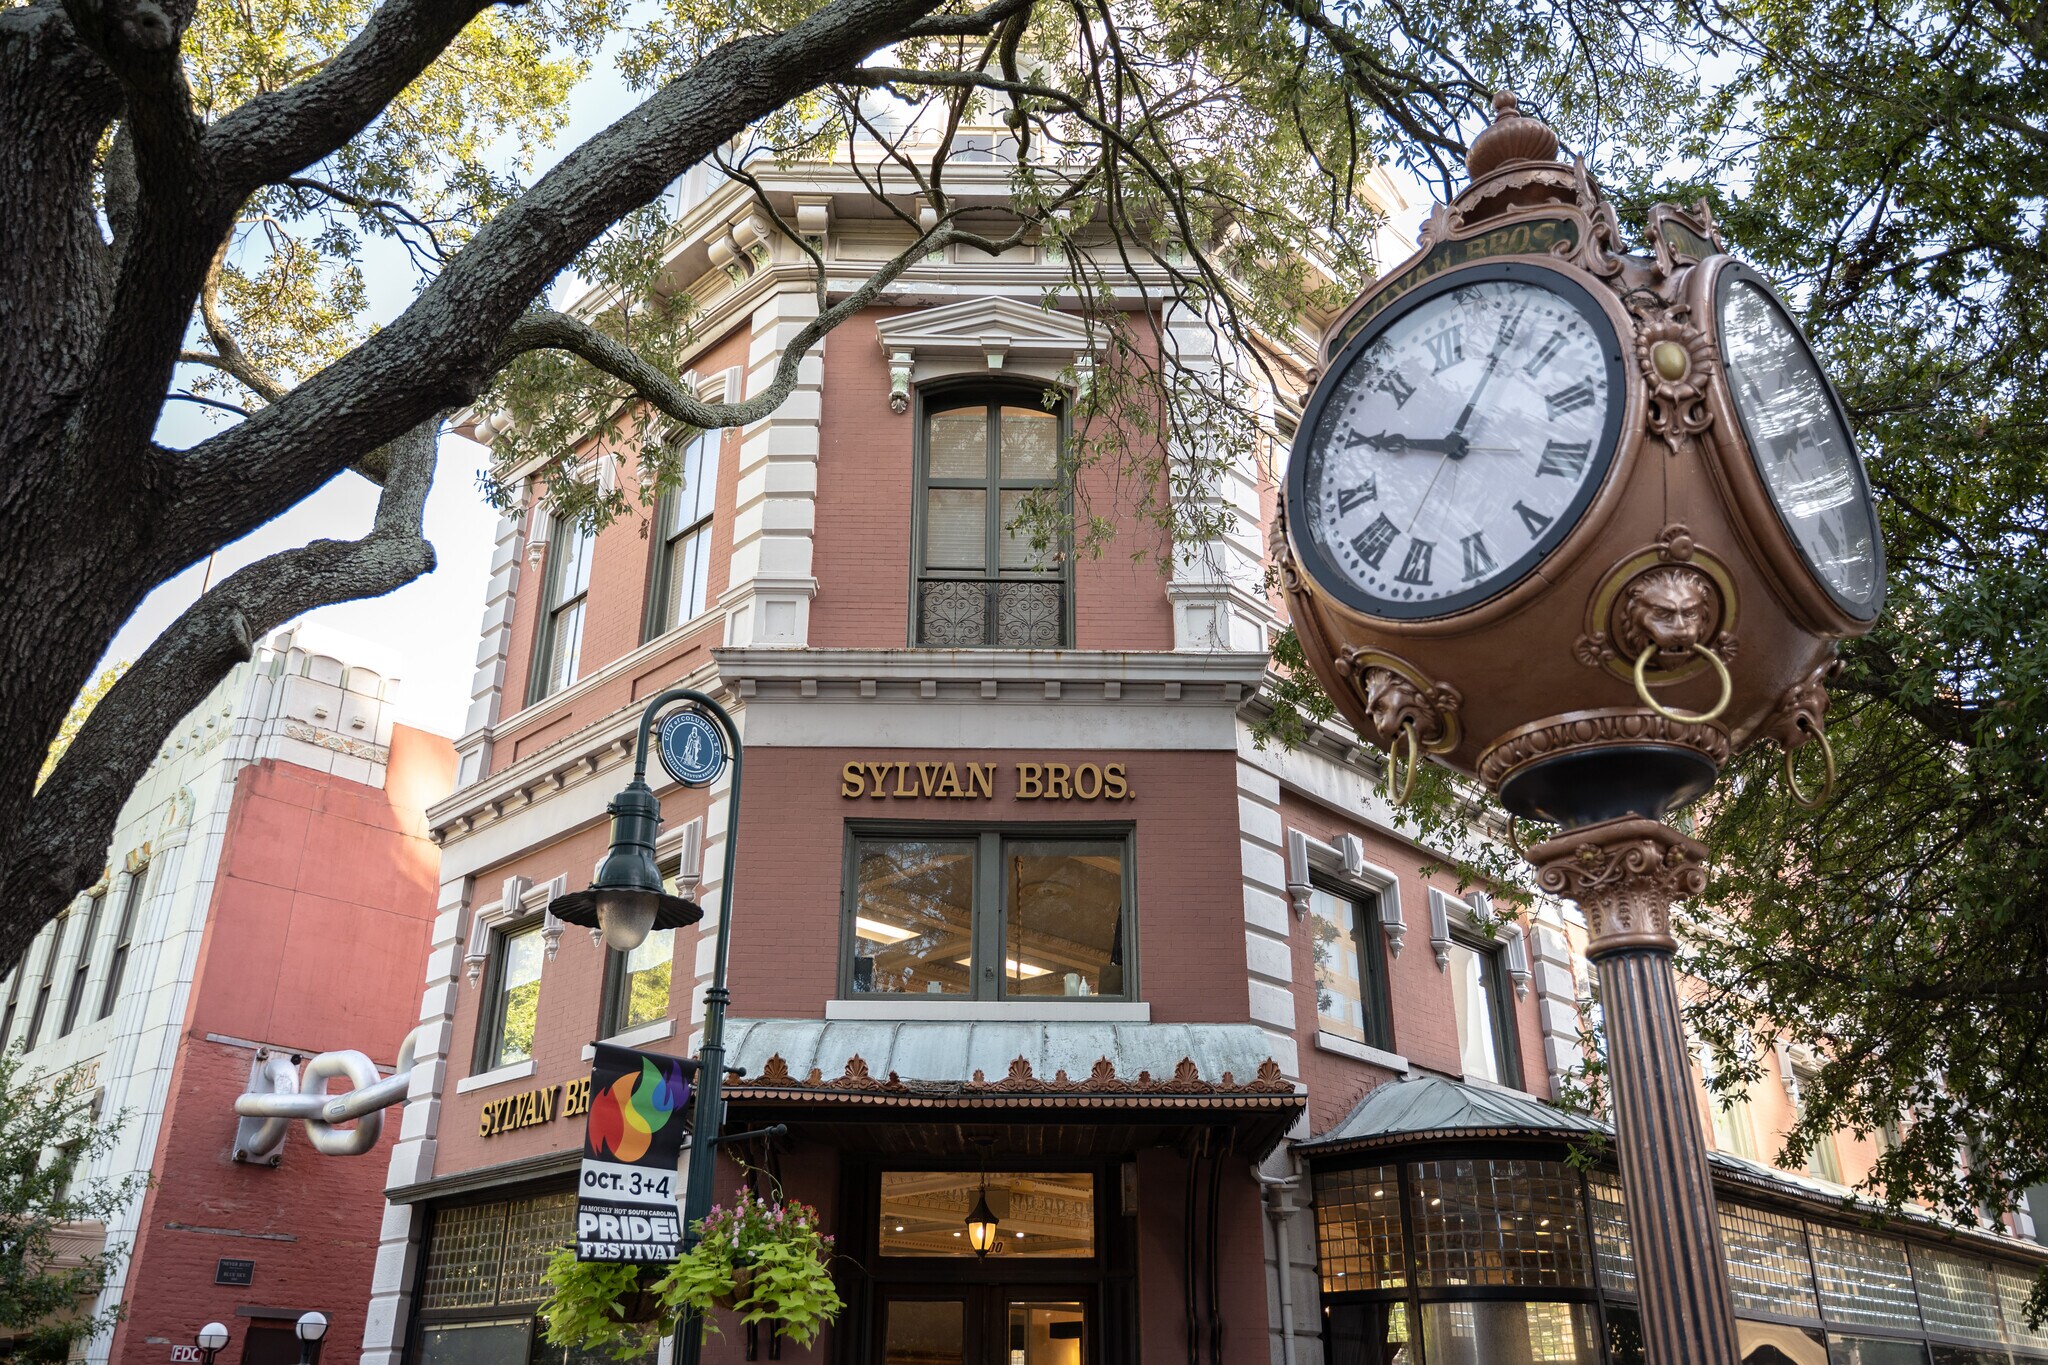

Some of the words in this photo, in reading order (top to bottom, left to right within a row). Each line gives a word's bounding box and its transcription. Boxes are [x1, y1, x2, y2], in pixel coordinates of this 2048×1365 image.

[1421, 322, 1465, 376] XII
[1522, 330, 1571, 380] II
[1545, 375, 1595, 421] III
[1512, 500, 1554, 540] V
[665, 723, 676, 741] CITY
[841, 761, 997, 798] SYLVAN
[1015, 762, 1136, 799] BROS.
[479, 1085, 557, 1137] SYLVAN
[561, 1076, 591, 1118] BR
[584, 1170, 624, 1190] OCT.
[629, 1172, 670, 1198] 3+4
[579, 1212, 680, 1242] PRIDE!
[580, 1204, 613, 1214] FAMOUSLY
[628, 1208, 648, 1216] SOUTH
[580, 1241, 678, 1260] FESTIVAL
[173, 1347, 200, 1361] FDC
